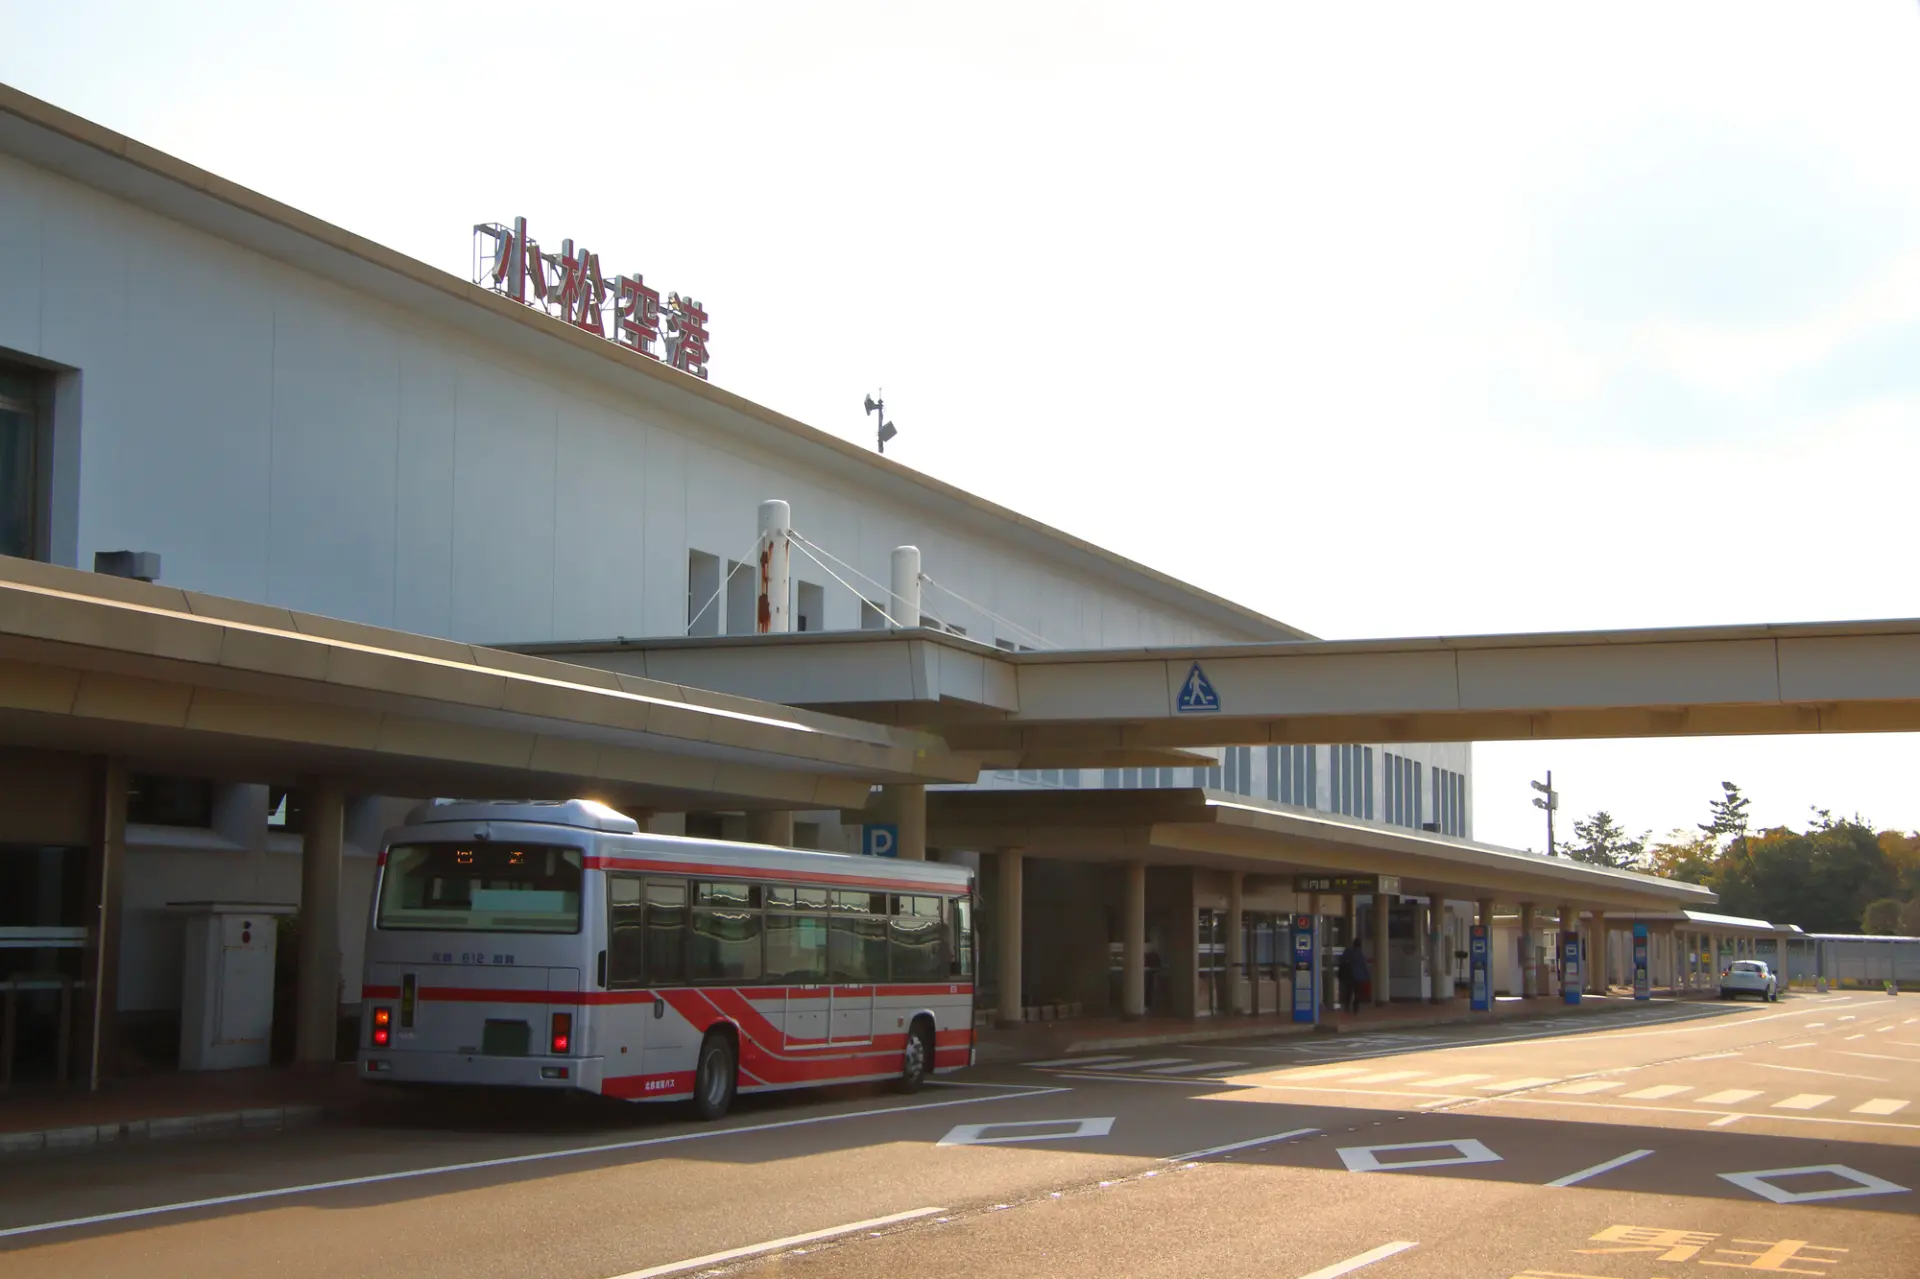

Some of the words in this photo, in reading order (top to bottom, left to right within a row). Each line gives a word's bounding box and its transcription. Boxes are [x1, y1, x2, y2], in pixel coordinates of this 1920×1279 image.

[491, 216, 710, 381] 小松空港
[871, 829, 893, 857] P
